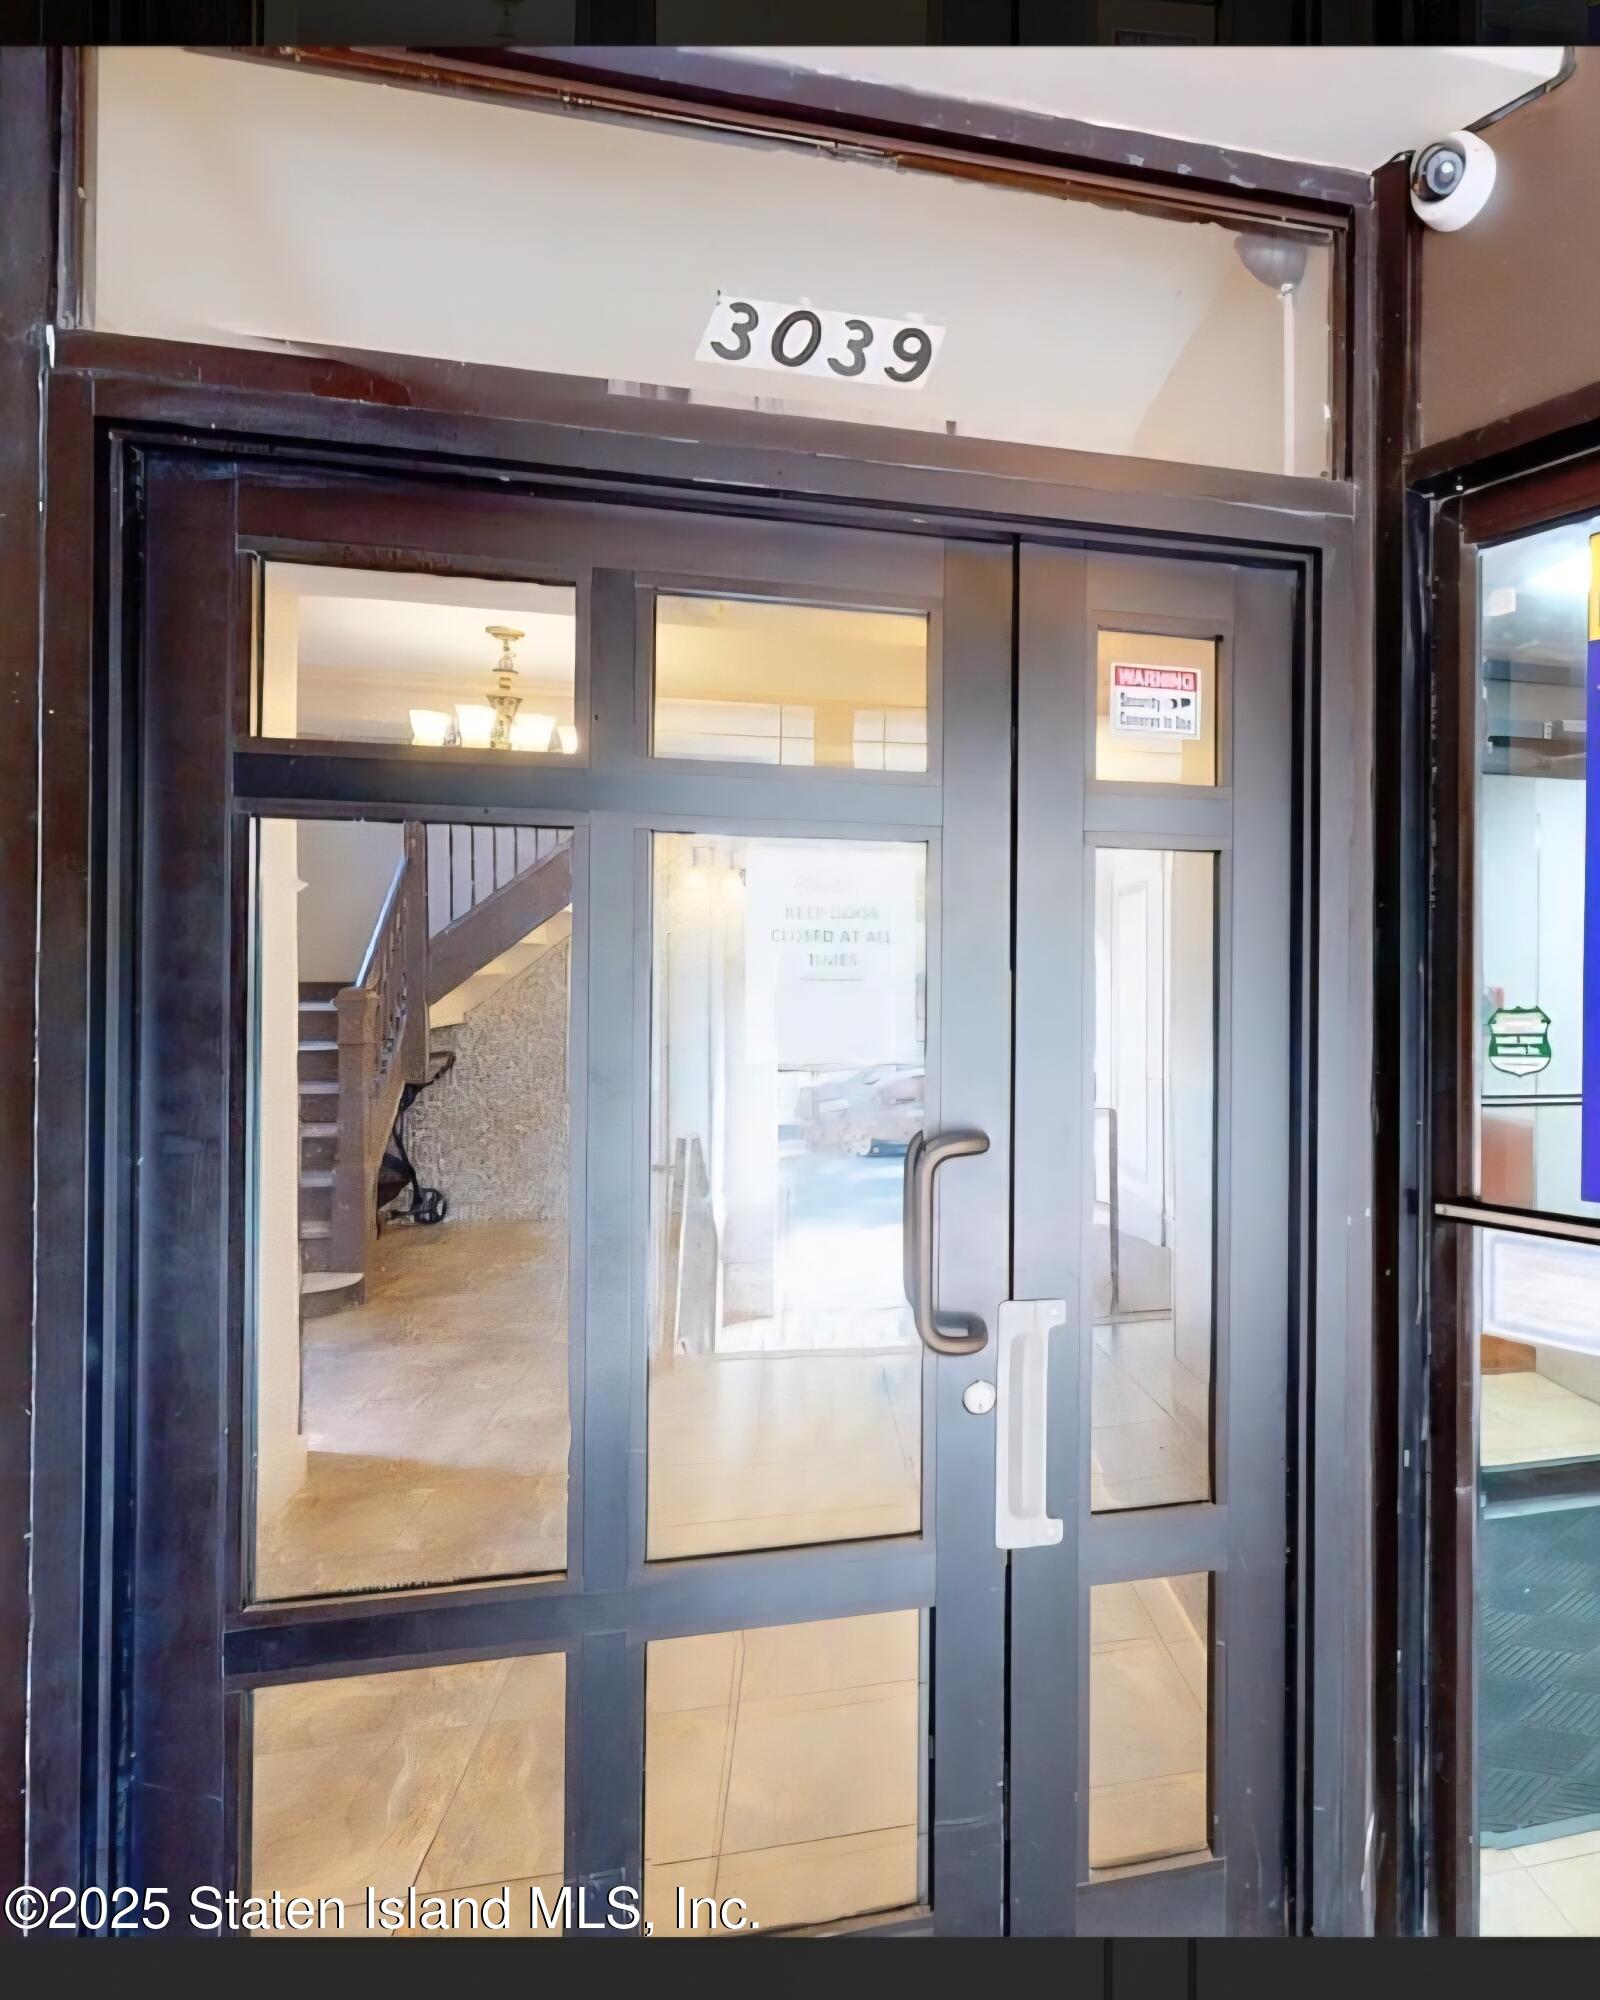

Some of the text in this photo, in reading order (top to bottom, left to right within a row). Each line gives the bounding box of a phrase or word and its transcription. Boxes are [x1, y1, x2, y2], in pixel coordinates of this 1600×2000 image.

[710, 301, 932, 384] 3039
[1118, 668, 1195, 691] WARNING
[840, 929, 860, 944] AT
